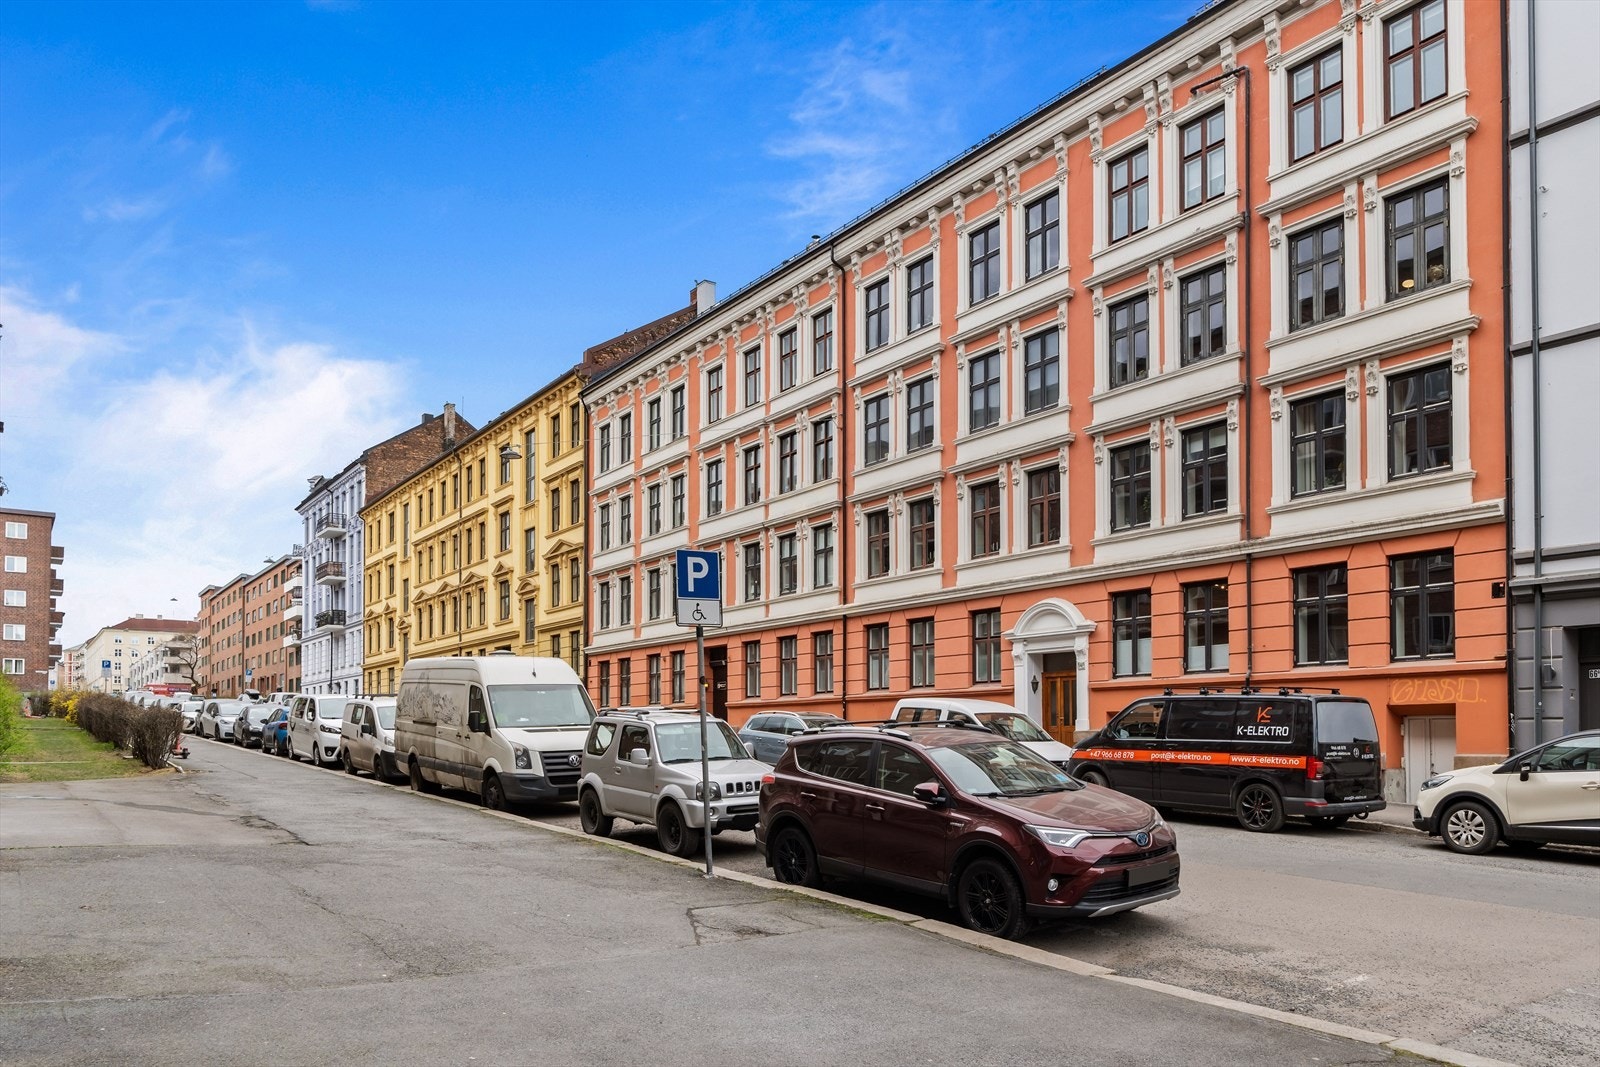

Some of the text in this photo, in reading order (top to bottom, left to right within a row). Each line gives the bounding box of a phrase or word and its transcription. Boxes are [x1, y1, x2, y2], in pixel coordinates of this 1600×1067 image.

[687, 556, 709, 592] P
[1236, 725, 1289, 736] K-ELEKTRO
[1101, 751, 1113, 759] 966
[1150, 752, 1212, 761] post@k-elektro.no
[1231, 755, 1300, 766] www.k-elektro.no
